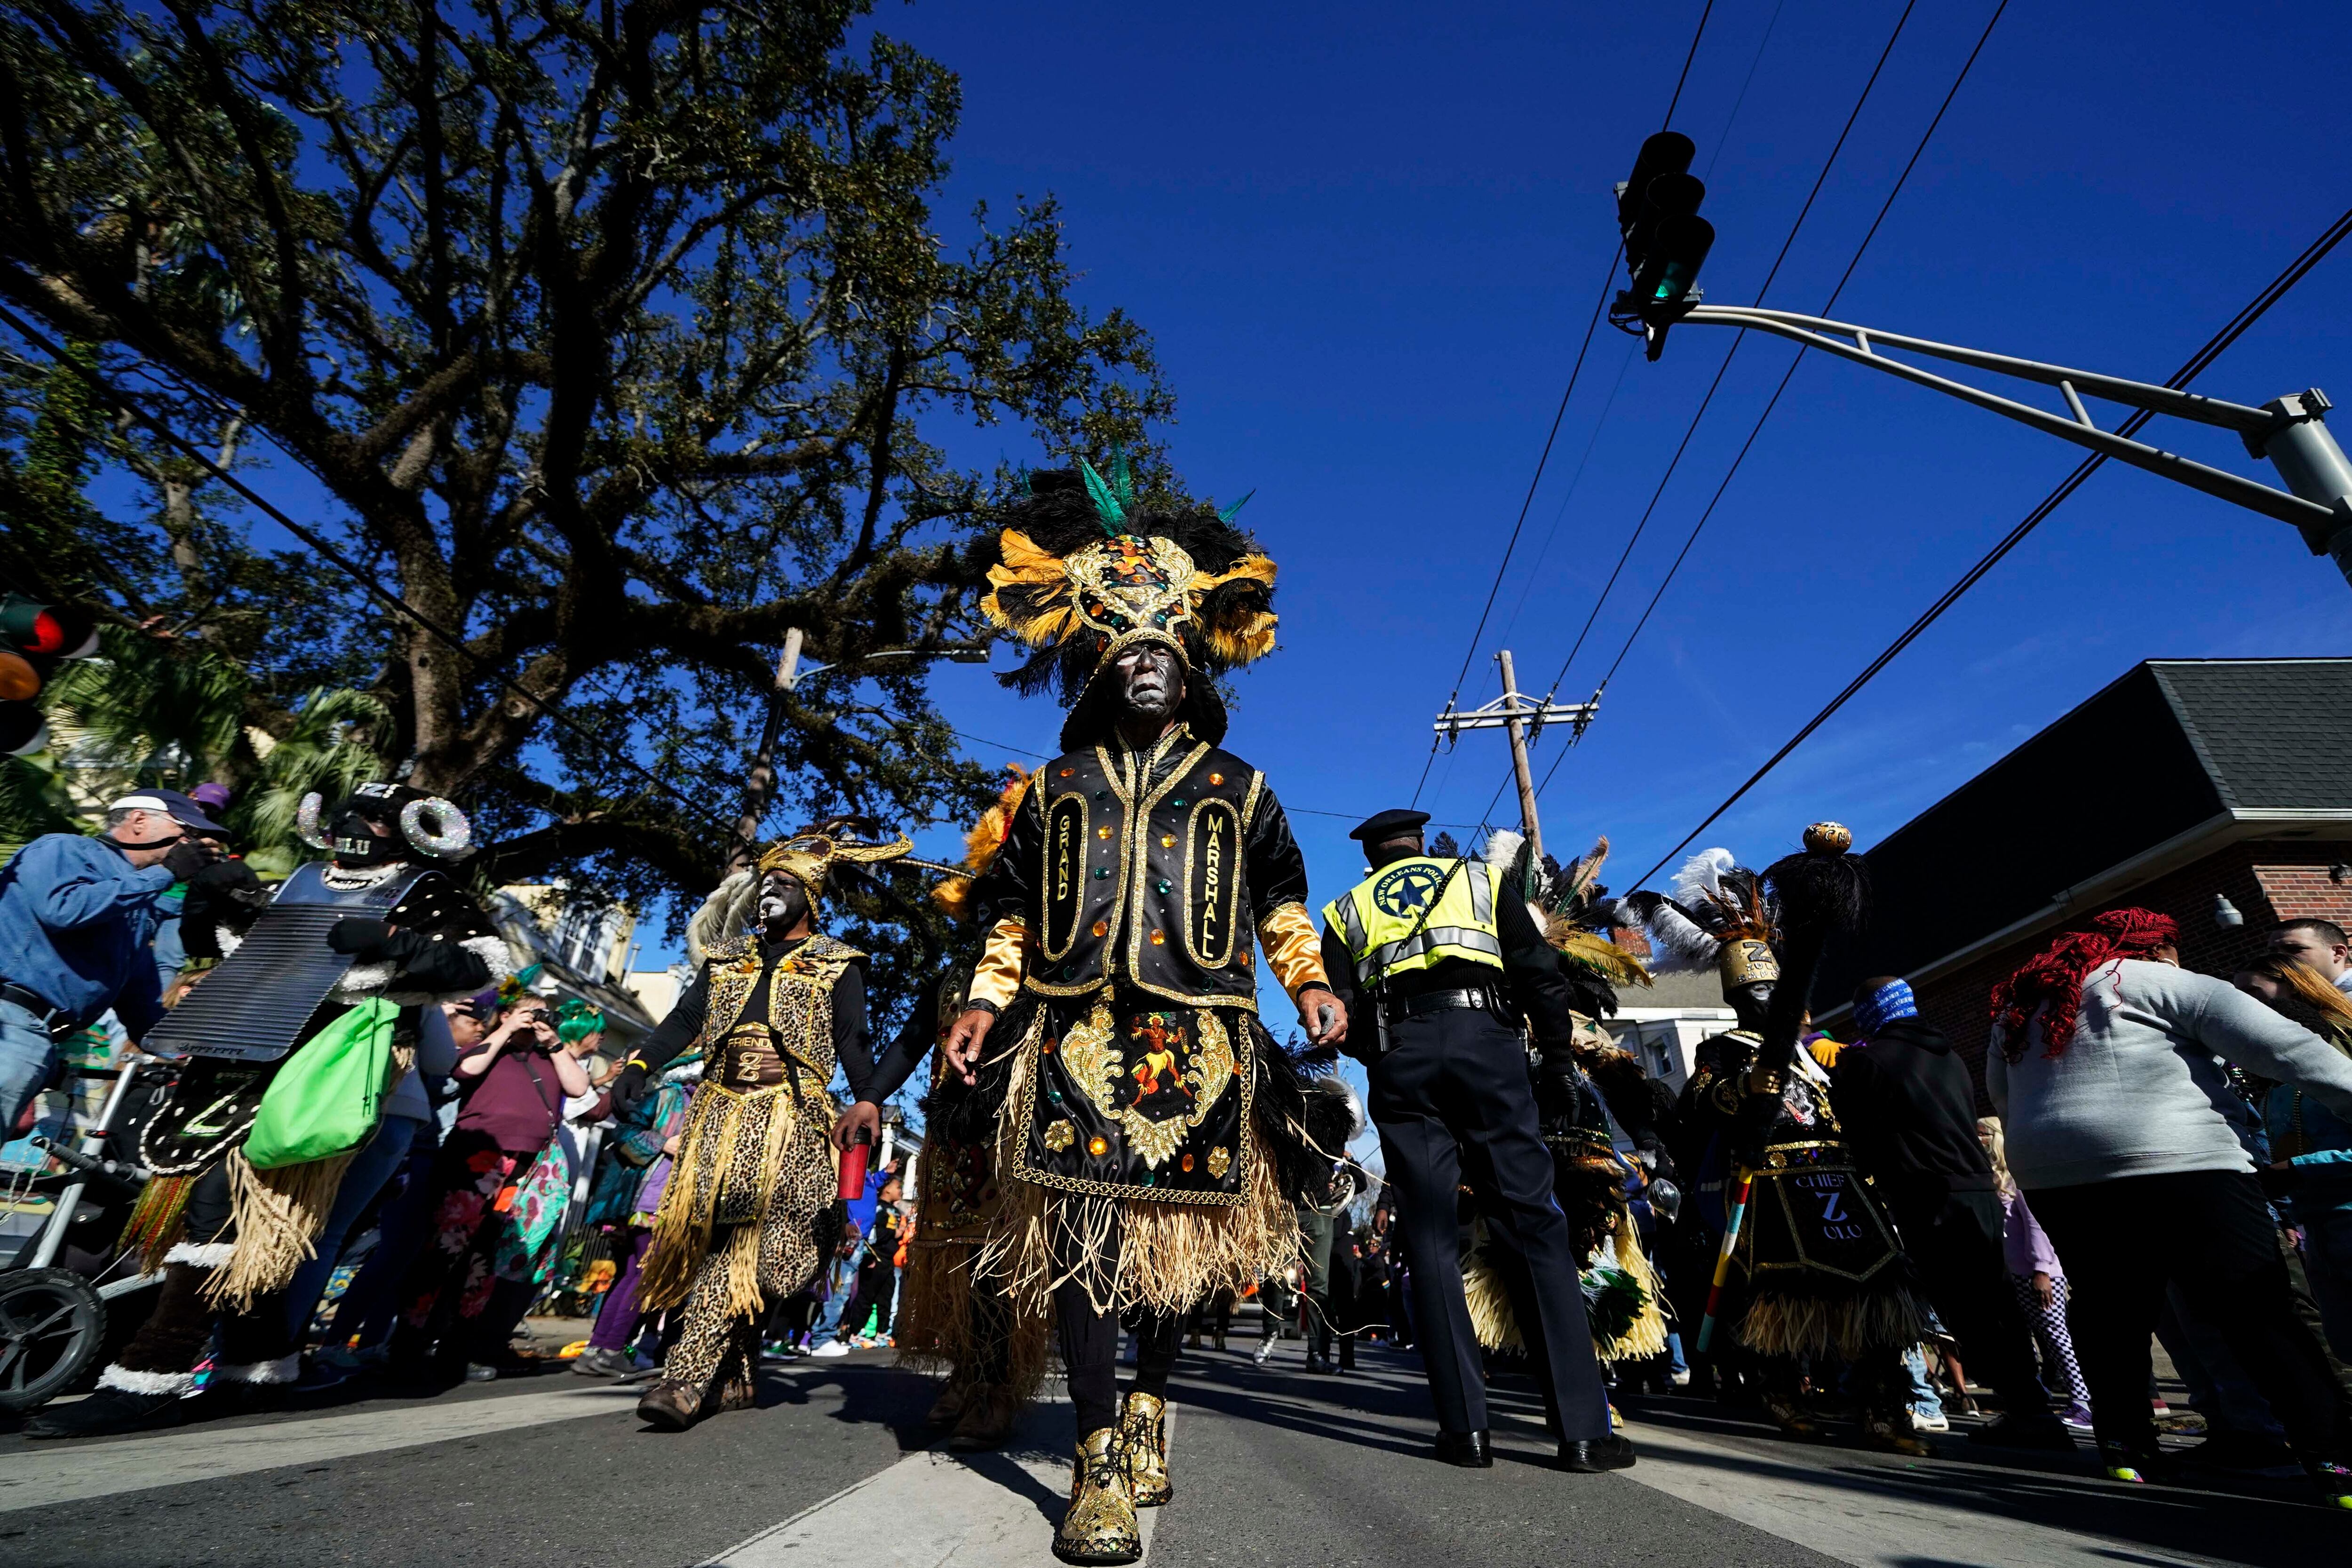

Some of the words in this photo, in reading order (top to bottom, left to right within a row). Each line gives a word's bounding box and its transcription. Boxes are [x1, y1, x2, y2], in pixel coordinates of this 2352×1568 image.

[1057, 814, 1071, 902] GRAND
[1201, 813, 1224, 959] MARSHALL
[1381, 866, 1423, 888] ORLEANS
[1423, 868, 1443, 889] POLIC
[1377, 889, 1386, 907] NEW
[1742, 942, 1772, 963] Z
[736, 1051, 764, 1082] Z
[1795, 1173, 1844, 1188] CHIEF
[1815, 1191, 1848, 1222] Z
[1822, 1224, 1863, 1240] ULU
